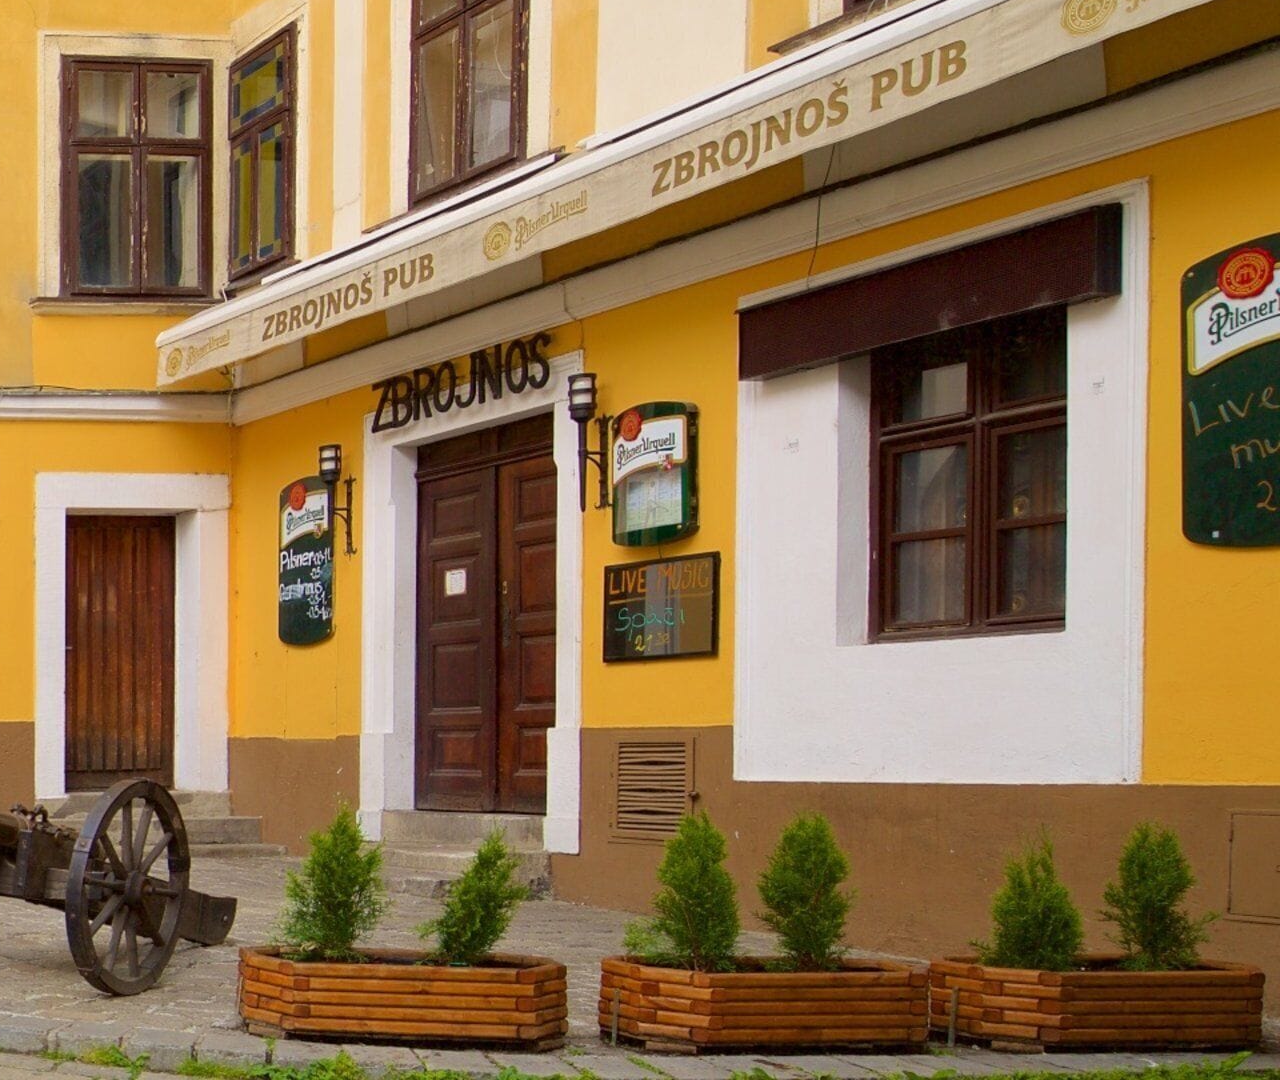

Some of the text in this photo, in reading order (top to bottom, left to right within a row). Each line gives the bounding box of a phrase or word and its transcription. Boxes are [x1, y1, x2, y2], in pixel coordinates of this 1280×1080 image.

[651, 39, 967, 197] ZBROJNOŠ PUB
[262, 253, 435, 341] ZBROJNOŠ PUB
[1208, 299, 1277, 346] Pilsner
[617, 433, 676, 470] Pilsner Urquell
[609, 560, 709, 595] LIVE MUSIC
